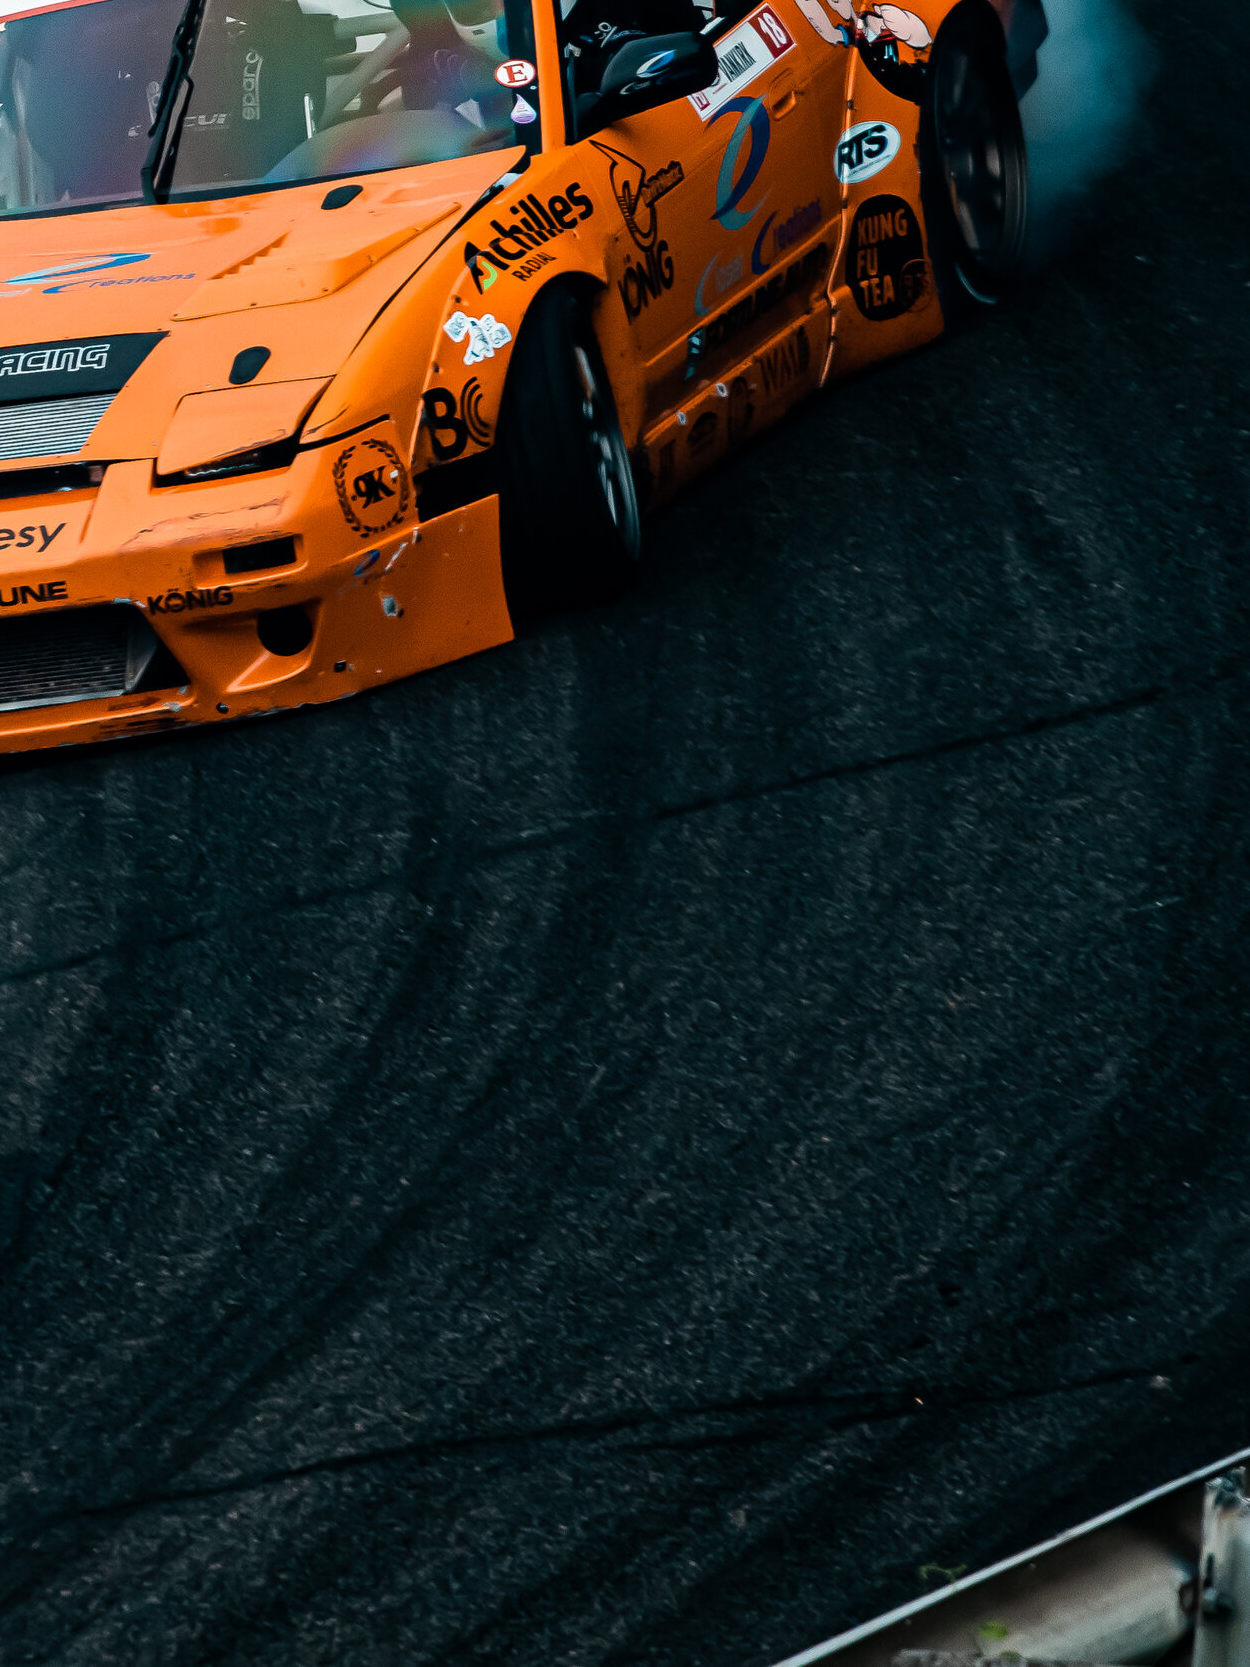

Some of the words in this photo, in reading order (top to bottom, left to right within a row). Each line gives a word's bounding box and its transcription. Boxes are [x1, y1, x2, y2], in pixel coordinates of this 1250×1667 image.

[758, 12, 787, 48] 18
[503, 63, 528, 83] E
[837, 124, 888, 176] RTS
[464, 182, 593, 295] Achilles
[857, 208, 908, 247] KUNG
[512, 252, 557, 282] RADIAL
[857, 246, 879, 279] FU
[859, 274, 895, 309] TEA
[147, 586, 233, 615] KÖNIG
